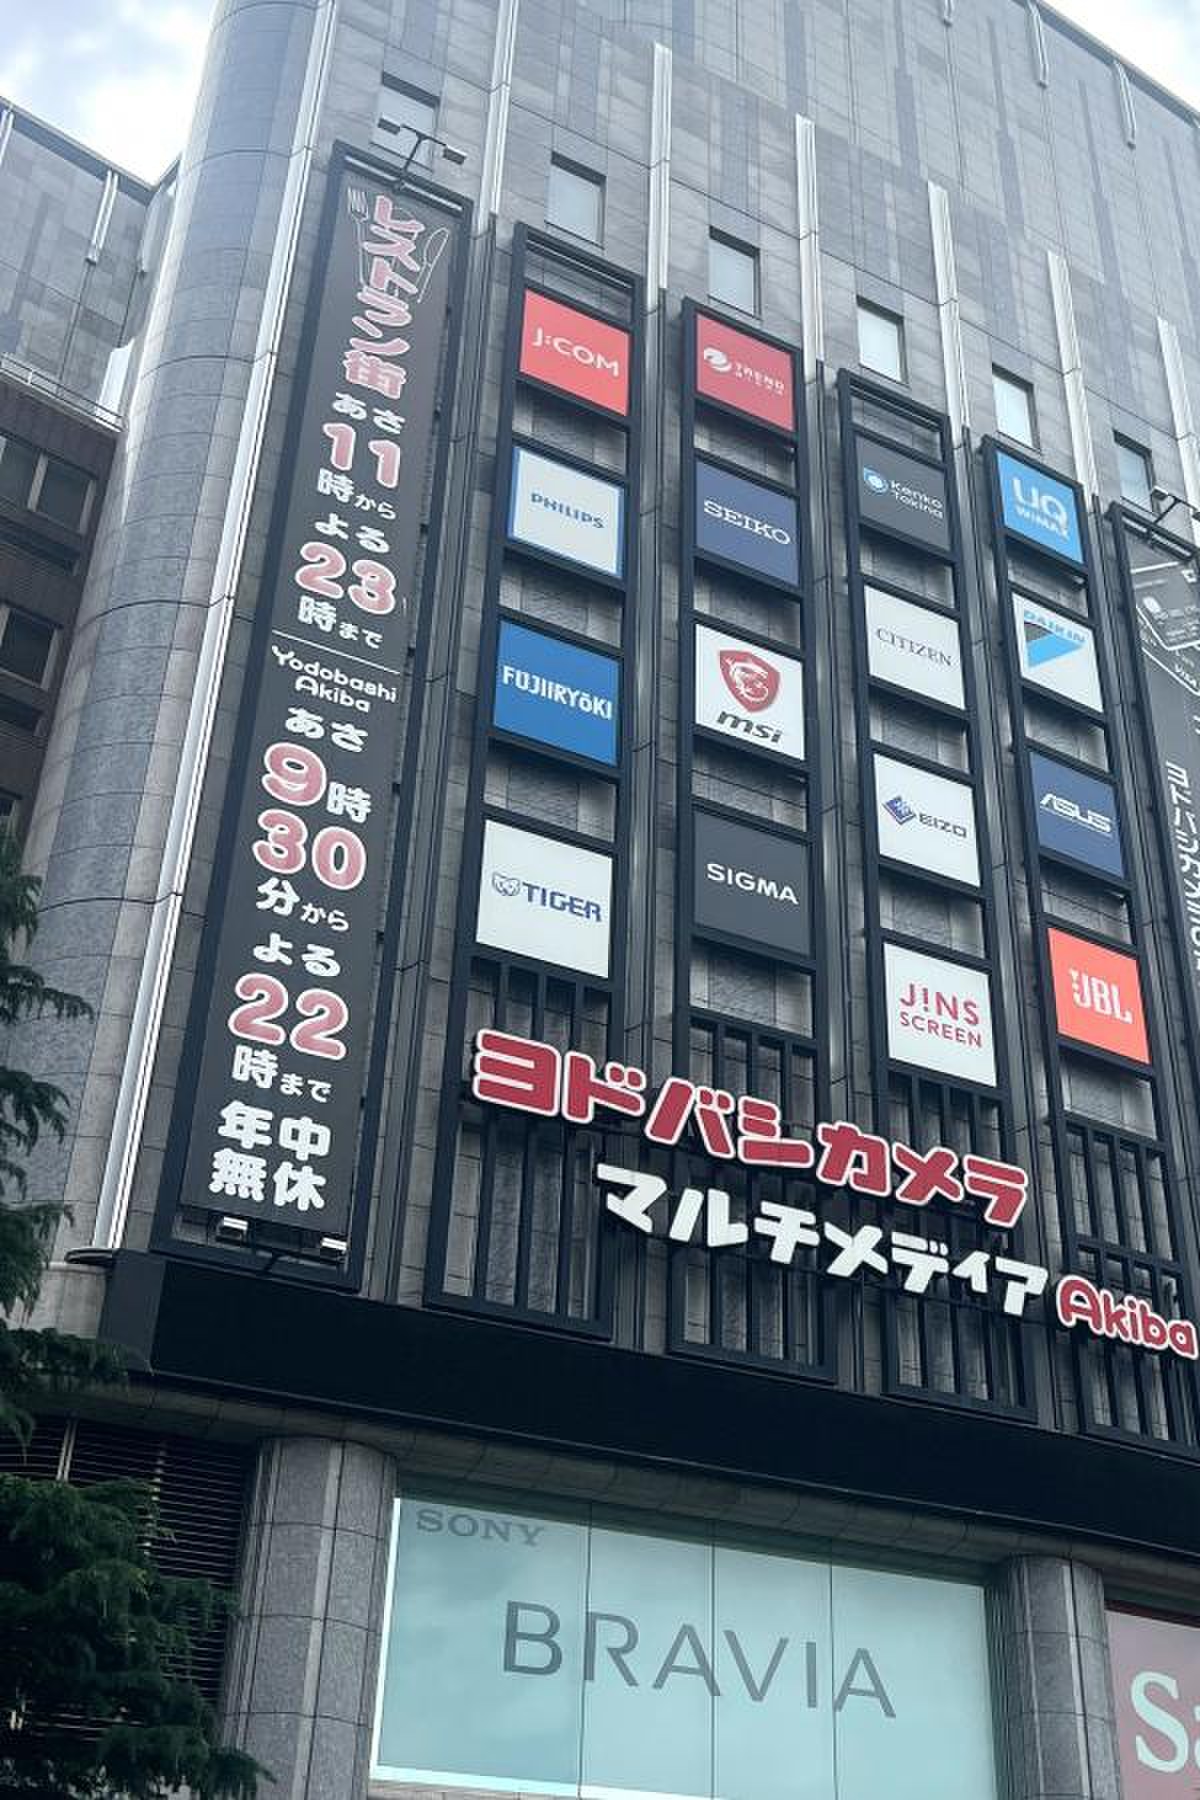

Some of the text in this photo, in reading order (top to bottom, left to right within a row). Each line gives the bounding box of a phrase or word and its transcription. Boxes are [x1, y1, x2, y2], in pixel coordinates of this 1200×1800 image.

[343, 194, 426, 400] レストラン街
[532, 327, 620, 377] J:COM
[332, 391, 406, 434] あさ
[322, 422, 401, 488] 11
[318, 469, 397, 520] 時から
[530, 492, 604, 528] PHILIPS
[1012, 477, 1069, 530] UQ
[315, 513, 390, 554] よる
[703, 500, 790, 545] SEIKO
[296, 541, 396, 615] 23
[296, 594, 384, 649] 時まで
[877, 627, 952, 666] CITIZEN
[1024, 609, 1085, 642] DAIKIN
[271, 645, 398, 703] Yodobashi
[295, 675, 370, 714] Akiba
[285, 706, 369, 753] あさ
[716, 710, 782, 743] msi
[1040, 792, 1113, 836] ASUS
[252, 809, 367, 890] 30
[256, 876, 349, 932] 分から
[522, 882, 602, 922] TIGER
[707, 862, 799, 905] SIGMA
[252, 933, 342, 977] よる
[227, 973, 349, 1060] 22
[900, 1010, 982, 1048] SCREEN
[231, 1045, 332, 1103] 時まで
[216, 1101, 330, 1161] 年中
[472, 1028, 1029, 1231] ヨドバシカメラ
[209, 1147, 326, 1211] 無休
[596, 1162, 1200, 1361] マルチメディア Akiba
[416, 1509, 544, 1547] SONY
[503, 1600, 896, 1718] BRAVIA
